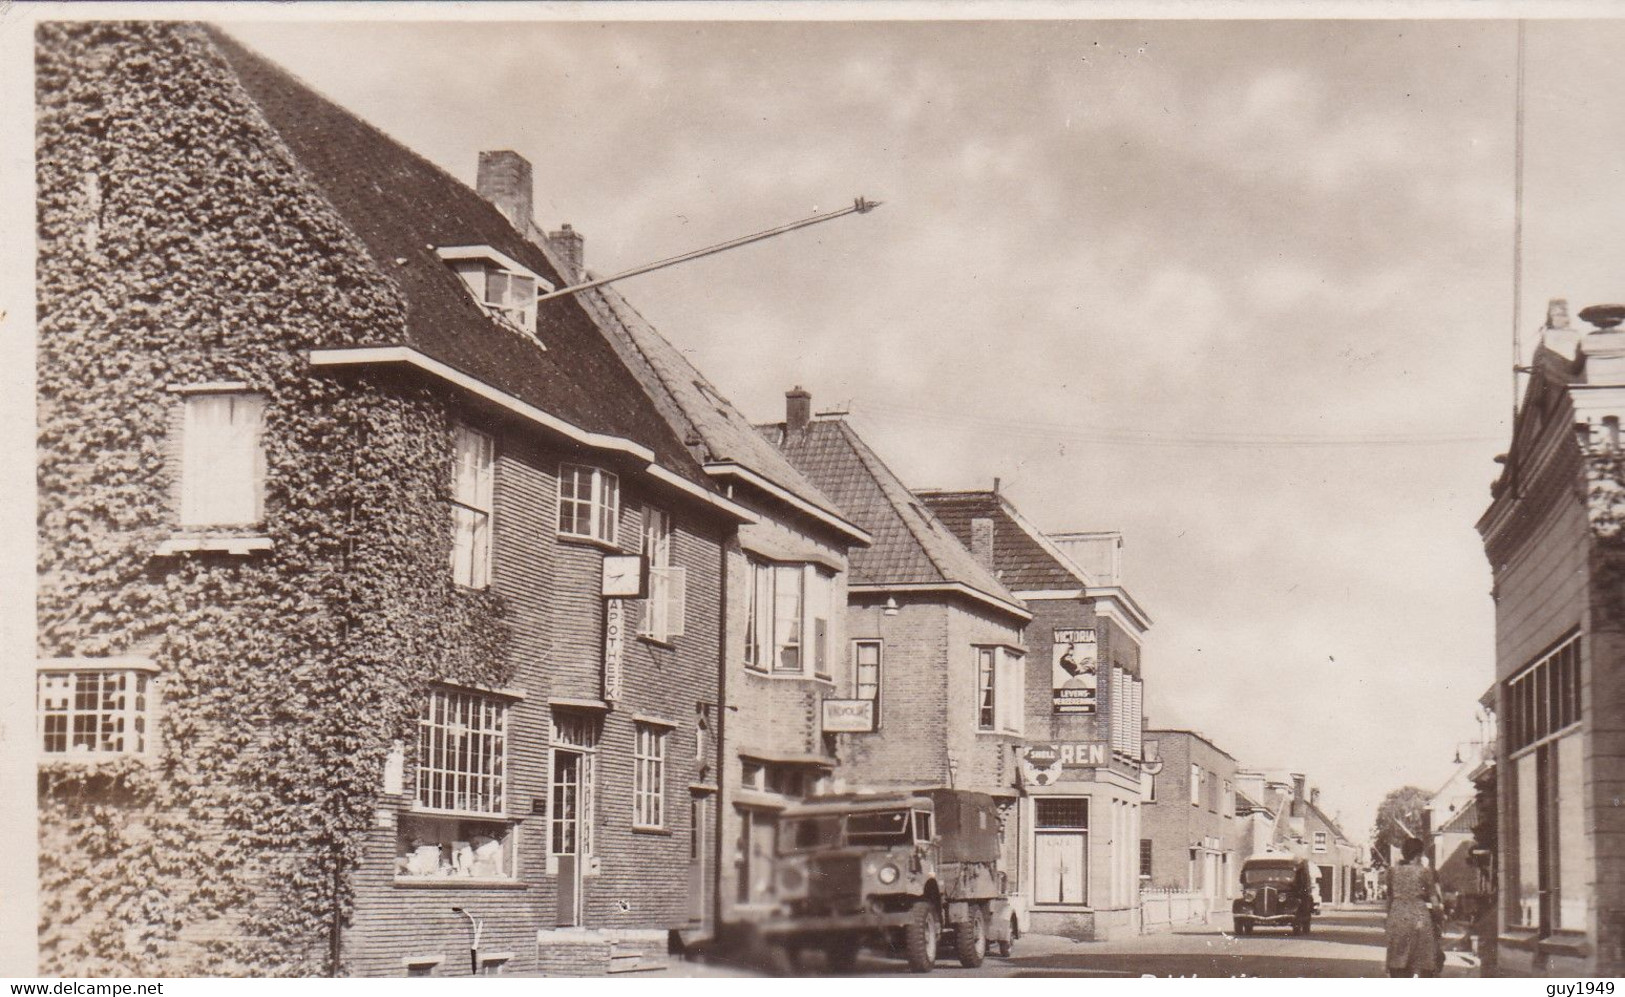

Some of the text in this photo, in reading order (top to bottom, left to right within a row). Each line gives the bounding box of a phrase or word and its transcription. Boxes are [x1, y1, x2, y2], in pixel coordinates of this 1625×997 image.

[1054, 630, 1096, 643] VICTORIA
[605, 599, 620, 698] APOTHEEK
[1030, 750, 1056, 760] SHELL
